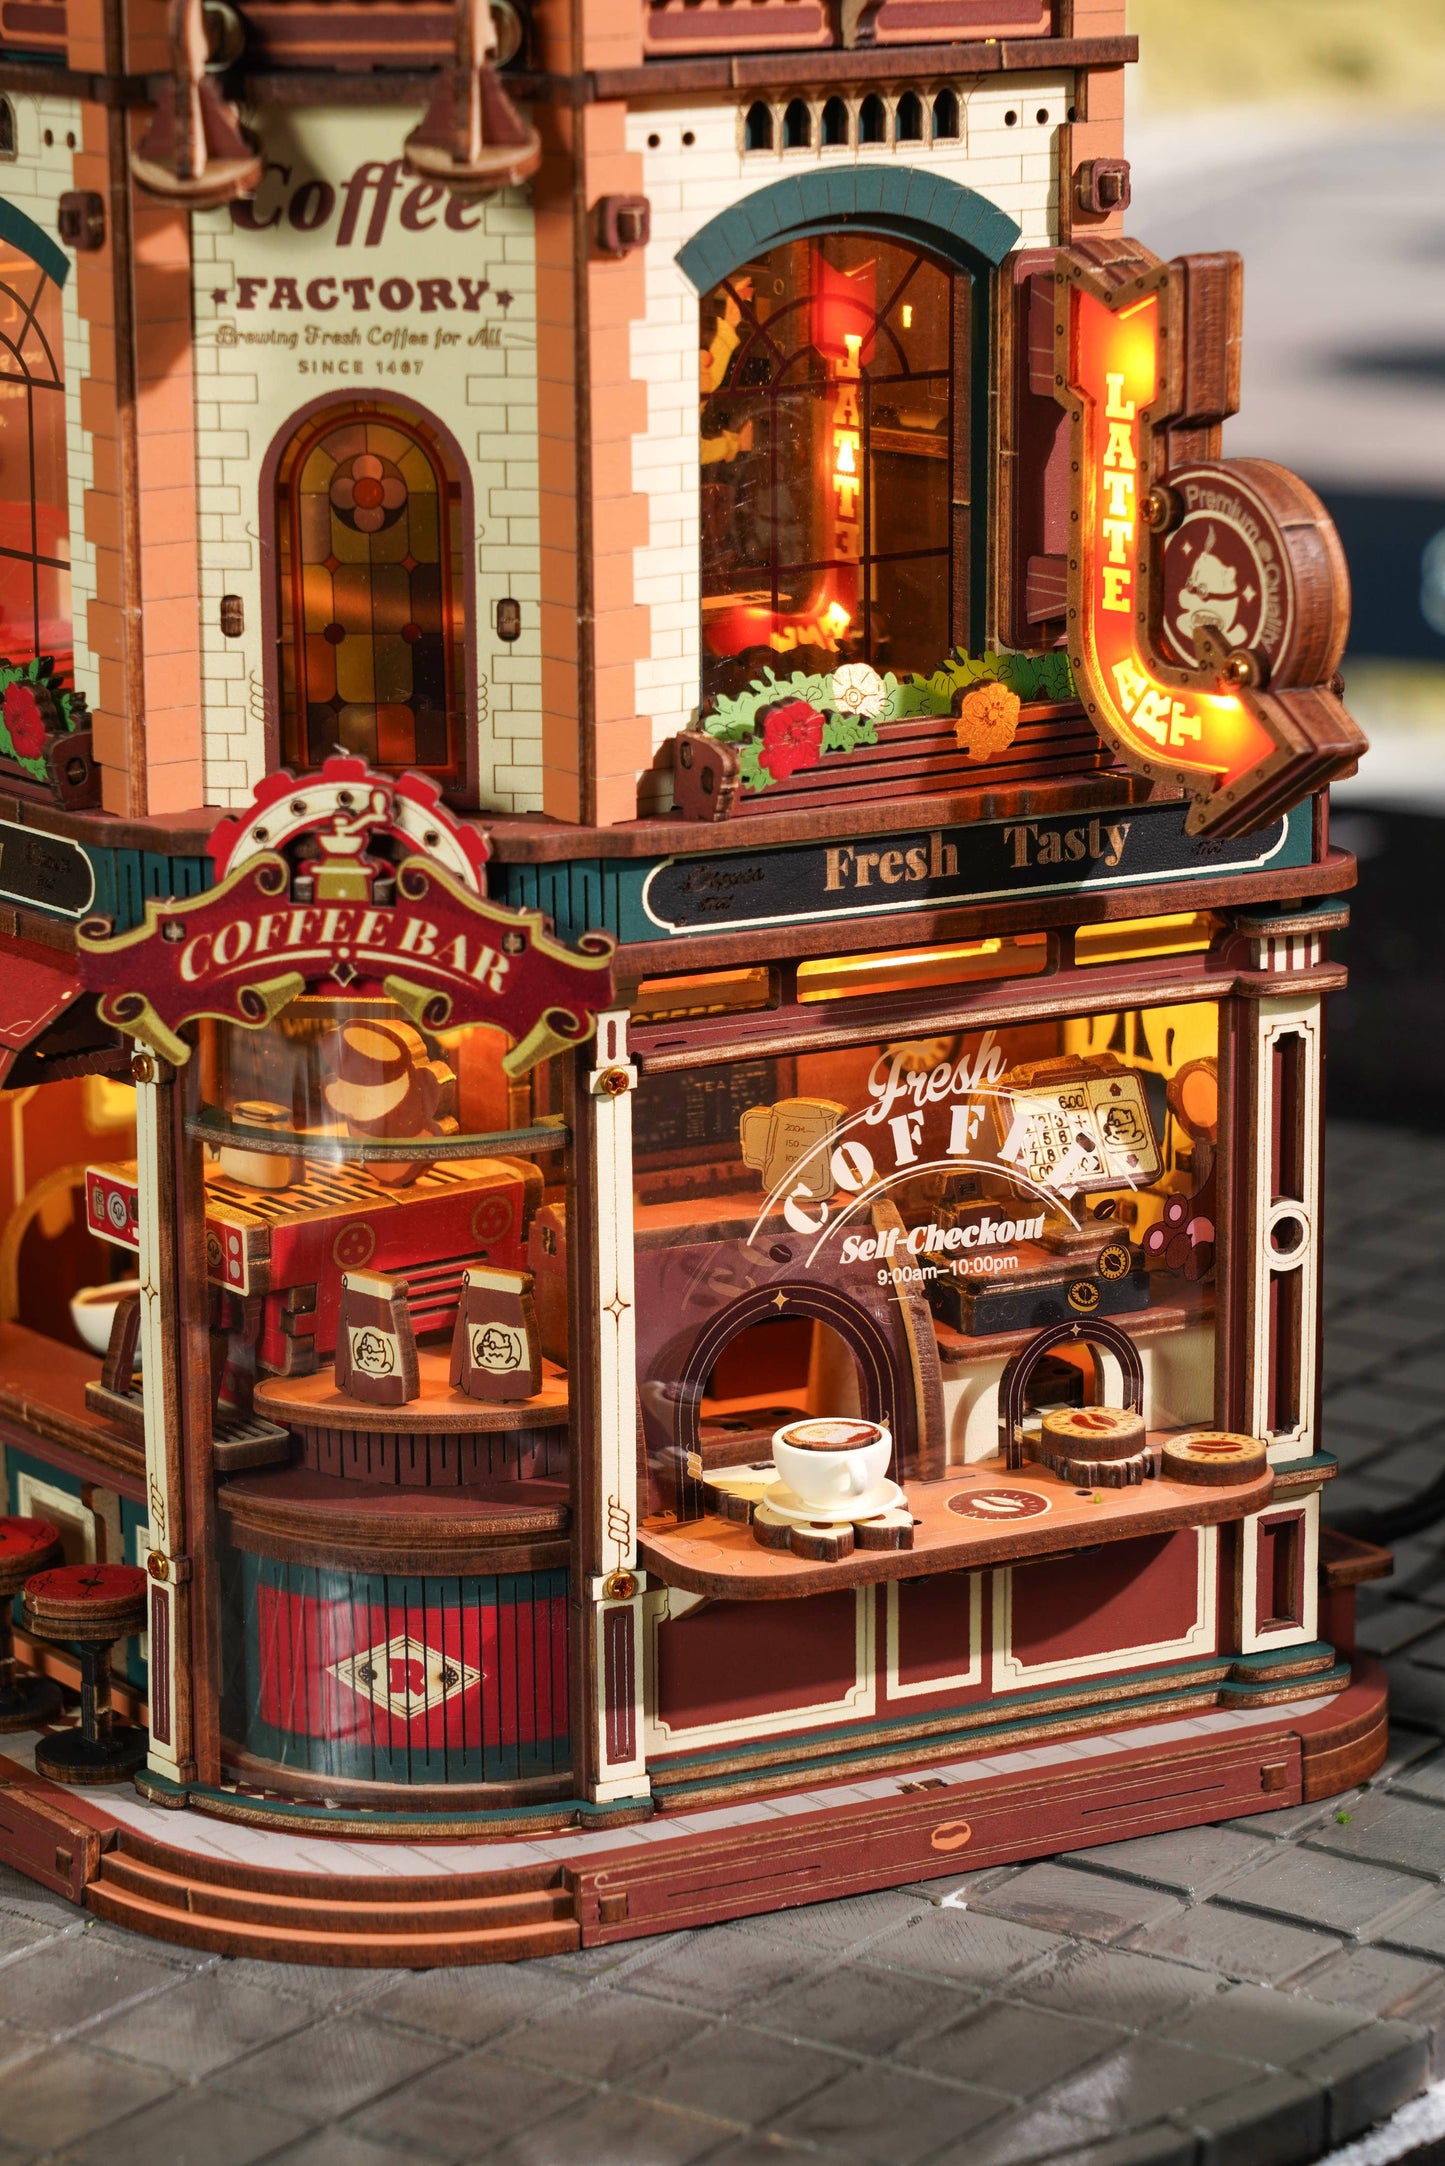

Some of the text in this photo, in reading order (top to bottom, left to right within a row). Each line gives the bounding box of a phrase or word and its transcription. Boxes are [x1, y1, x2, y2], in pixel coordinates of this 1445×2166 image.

[229, 158, 482, 248] Coffee
[236, 276, 490, 313] FACTORY
[215, 324, 502, 350] Brewing Fresh Coffee for All
[297, 360, 364, 374] SINCE
[1102, 373, 1137, 614] LATTE
[1185, 484, 1284, 655] Premium Quality
[1112, 657, 1202, 747] ART
[823, 830, 960, 892] Fresh
[1003, 818, 1132, 867] Tasty
[180, 908, 512, 995] COFFEE BAR
[868, 1030, 1007, 1125] Fresh
[1046, 1148, 1056, 1163] 8
[840, 1211, 1047, 1265] Self-Checkout
[388, 1656, 426, 1697] R
